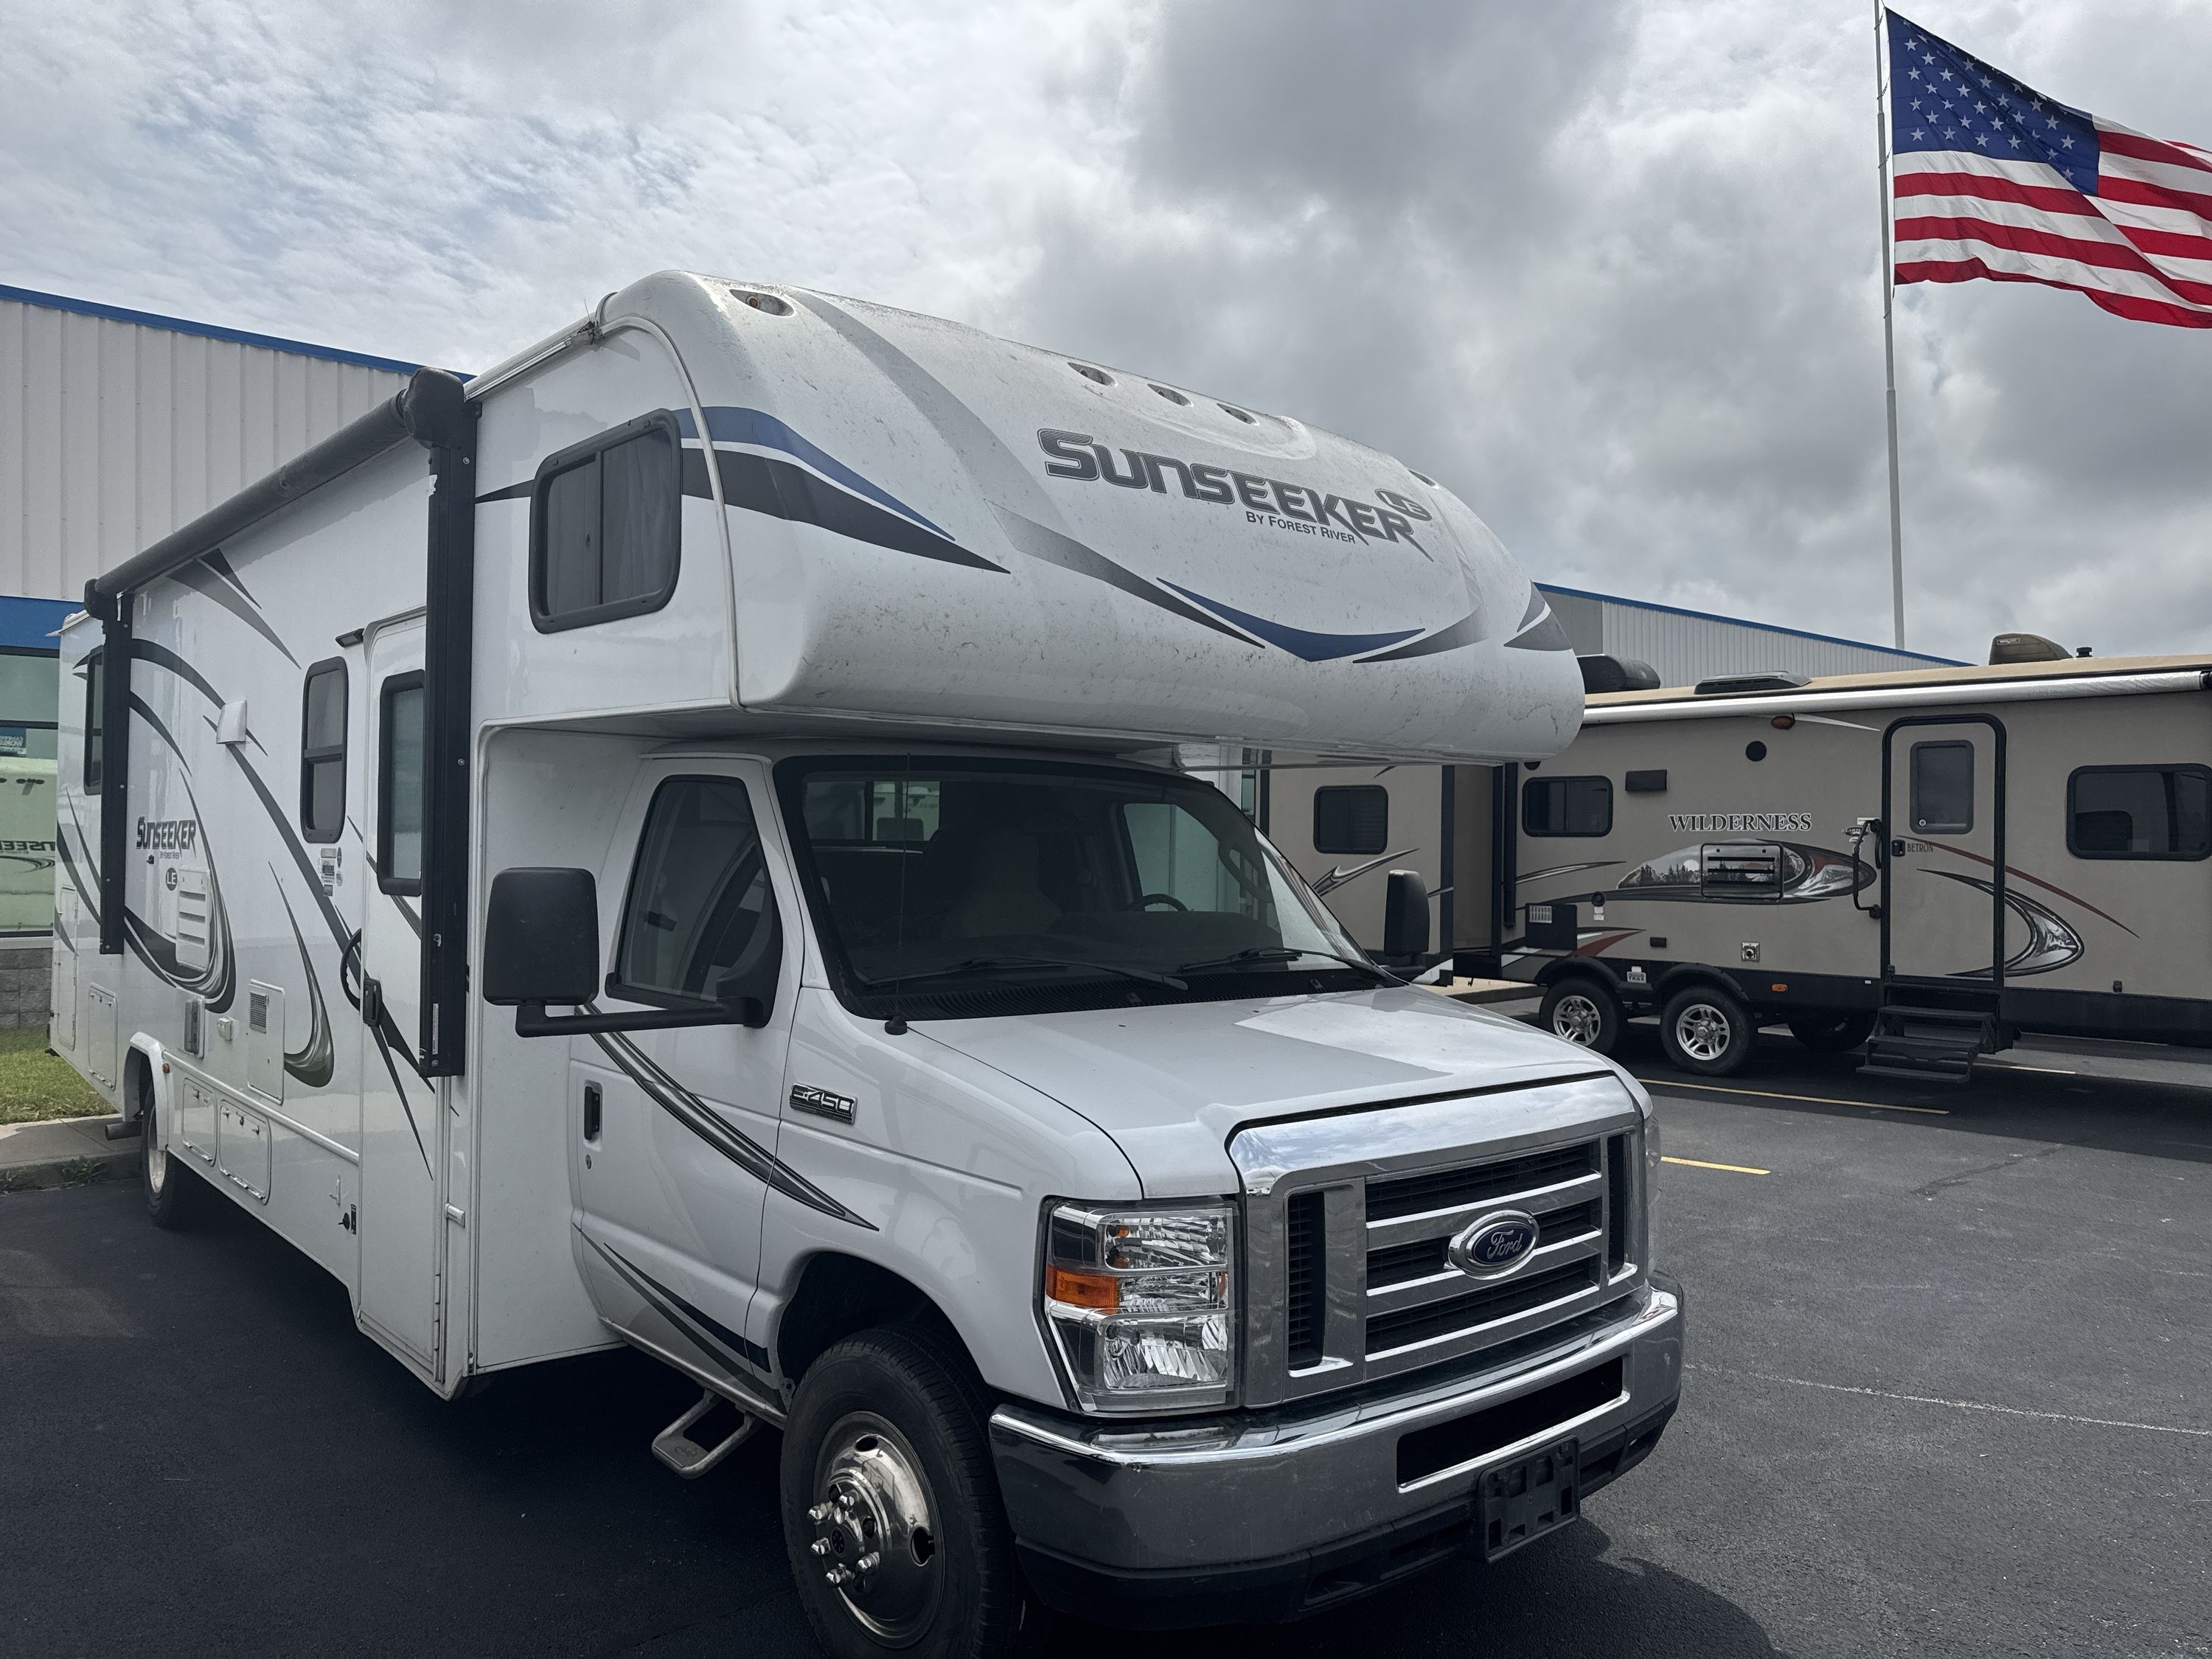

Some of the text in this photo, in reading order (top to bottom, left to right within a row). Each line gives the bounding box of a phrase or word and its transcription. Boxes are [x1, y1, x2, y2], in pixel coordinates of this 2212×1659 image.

[1037, 428, 1434, 563] SUNSEEKER
[1378, 491, 1427, 518] LE
[1246, 511, 1356, 544] BY FOREST RIVER
[136, 816, 196, 858] SUNSEEKER
[1668, 813, 1812, 832] WILDERNESS
[167, 872, 176, 886] LE
[1486, 1230, 1523, 1259] Ford
